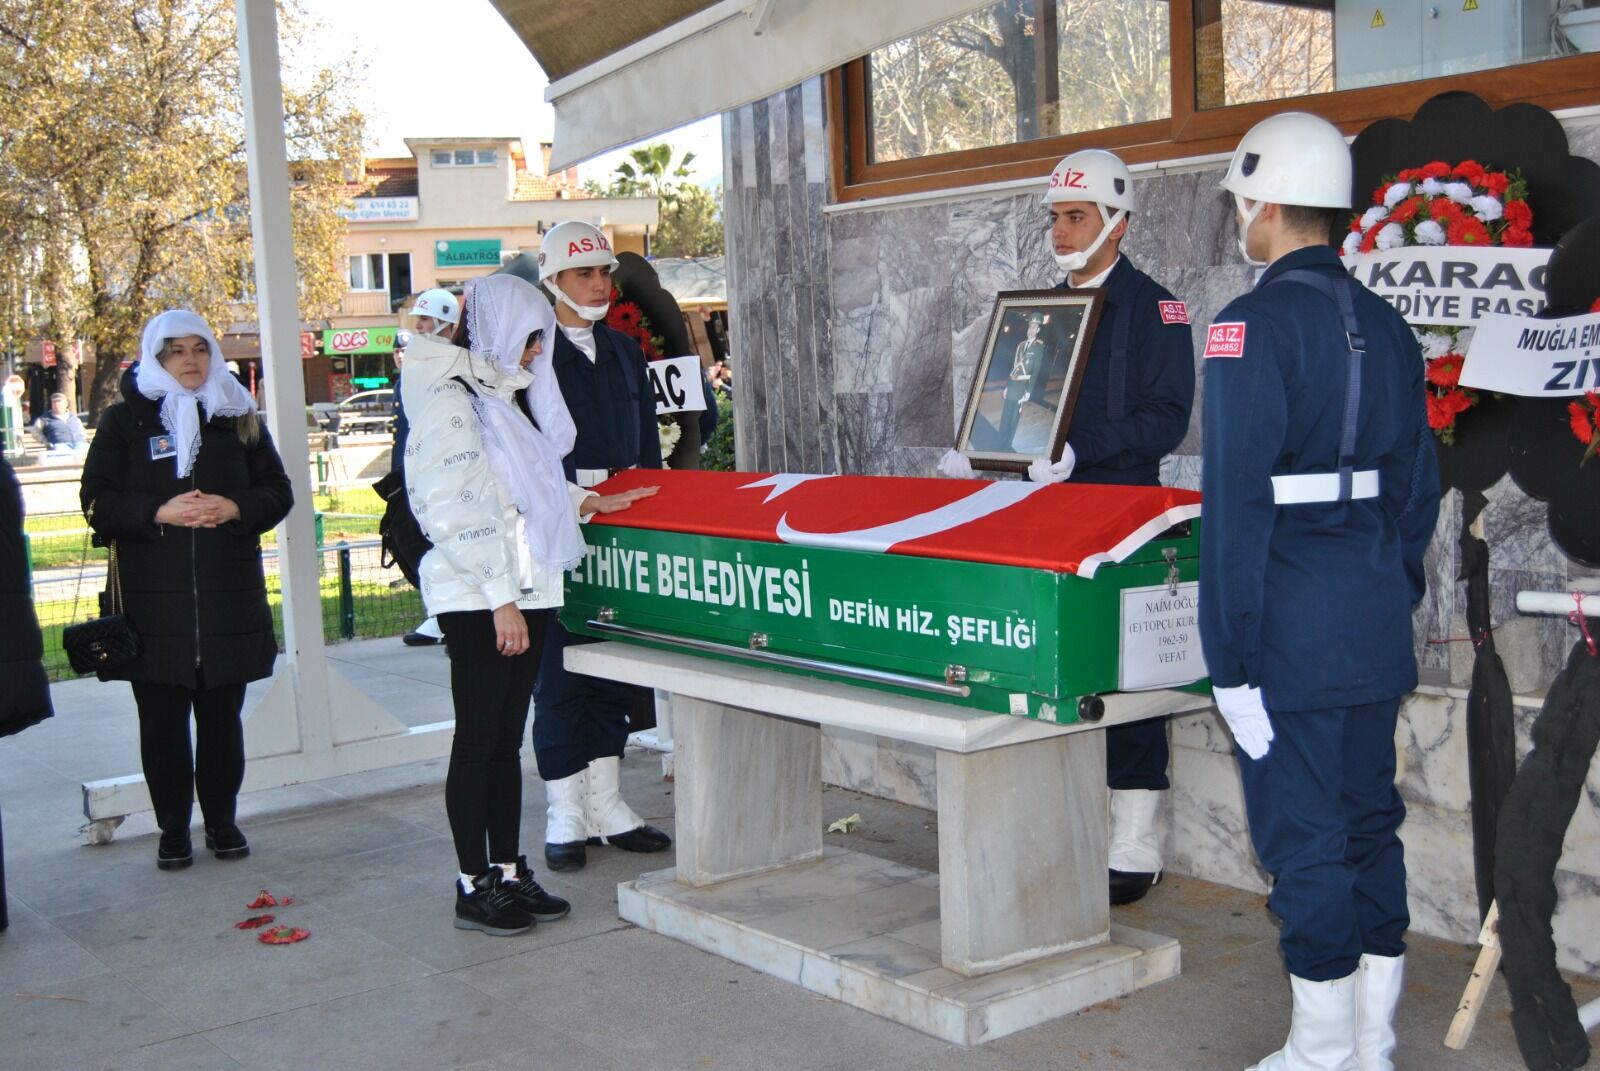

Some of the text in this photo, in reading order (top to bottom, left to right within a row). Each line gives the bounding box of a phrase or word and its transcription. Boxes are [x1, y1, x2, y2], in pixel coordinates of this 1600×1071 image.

[1049, 167, 1088, 189] S.İZ.
[399, 200, 409, 209] 22
[446, 251, 500, 261] ALBATROS
[1517, 322, 1600, 351] MUĞLA EM
[570, 537, 650, 594] ETHİYE
[656, 552, 812, 618] BELEDİYESİ
[829, 598, 889, 629] DEFİN
[896, 604, 940, 636] HİZ.
[1173, 595, 1199, 610] OĞU
[1144, 619, 1175, 632] TOPÇU
[1176, 615, 1198, 629] KUR
[1158, 651, 1187, 663] VEFAT
